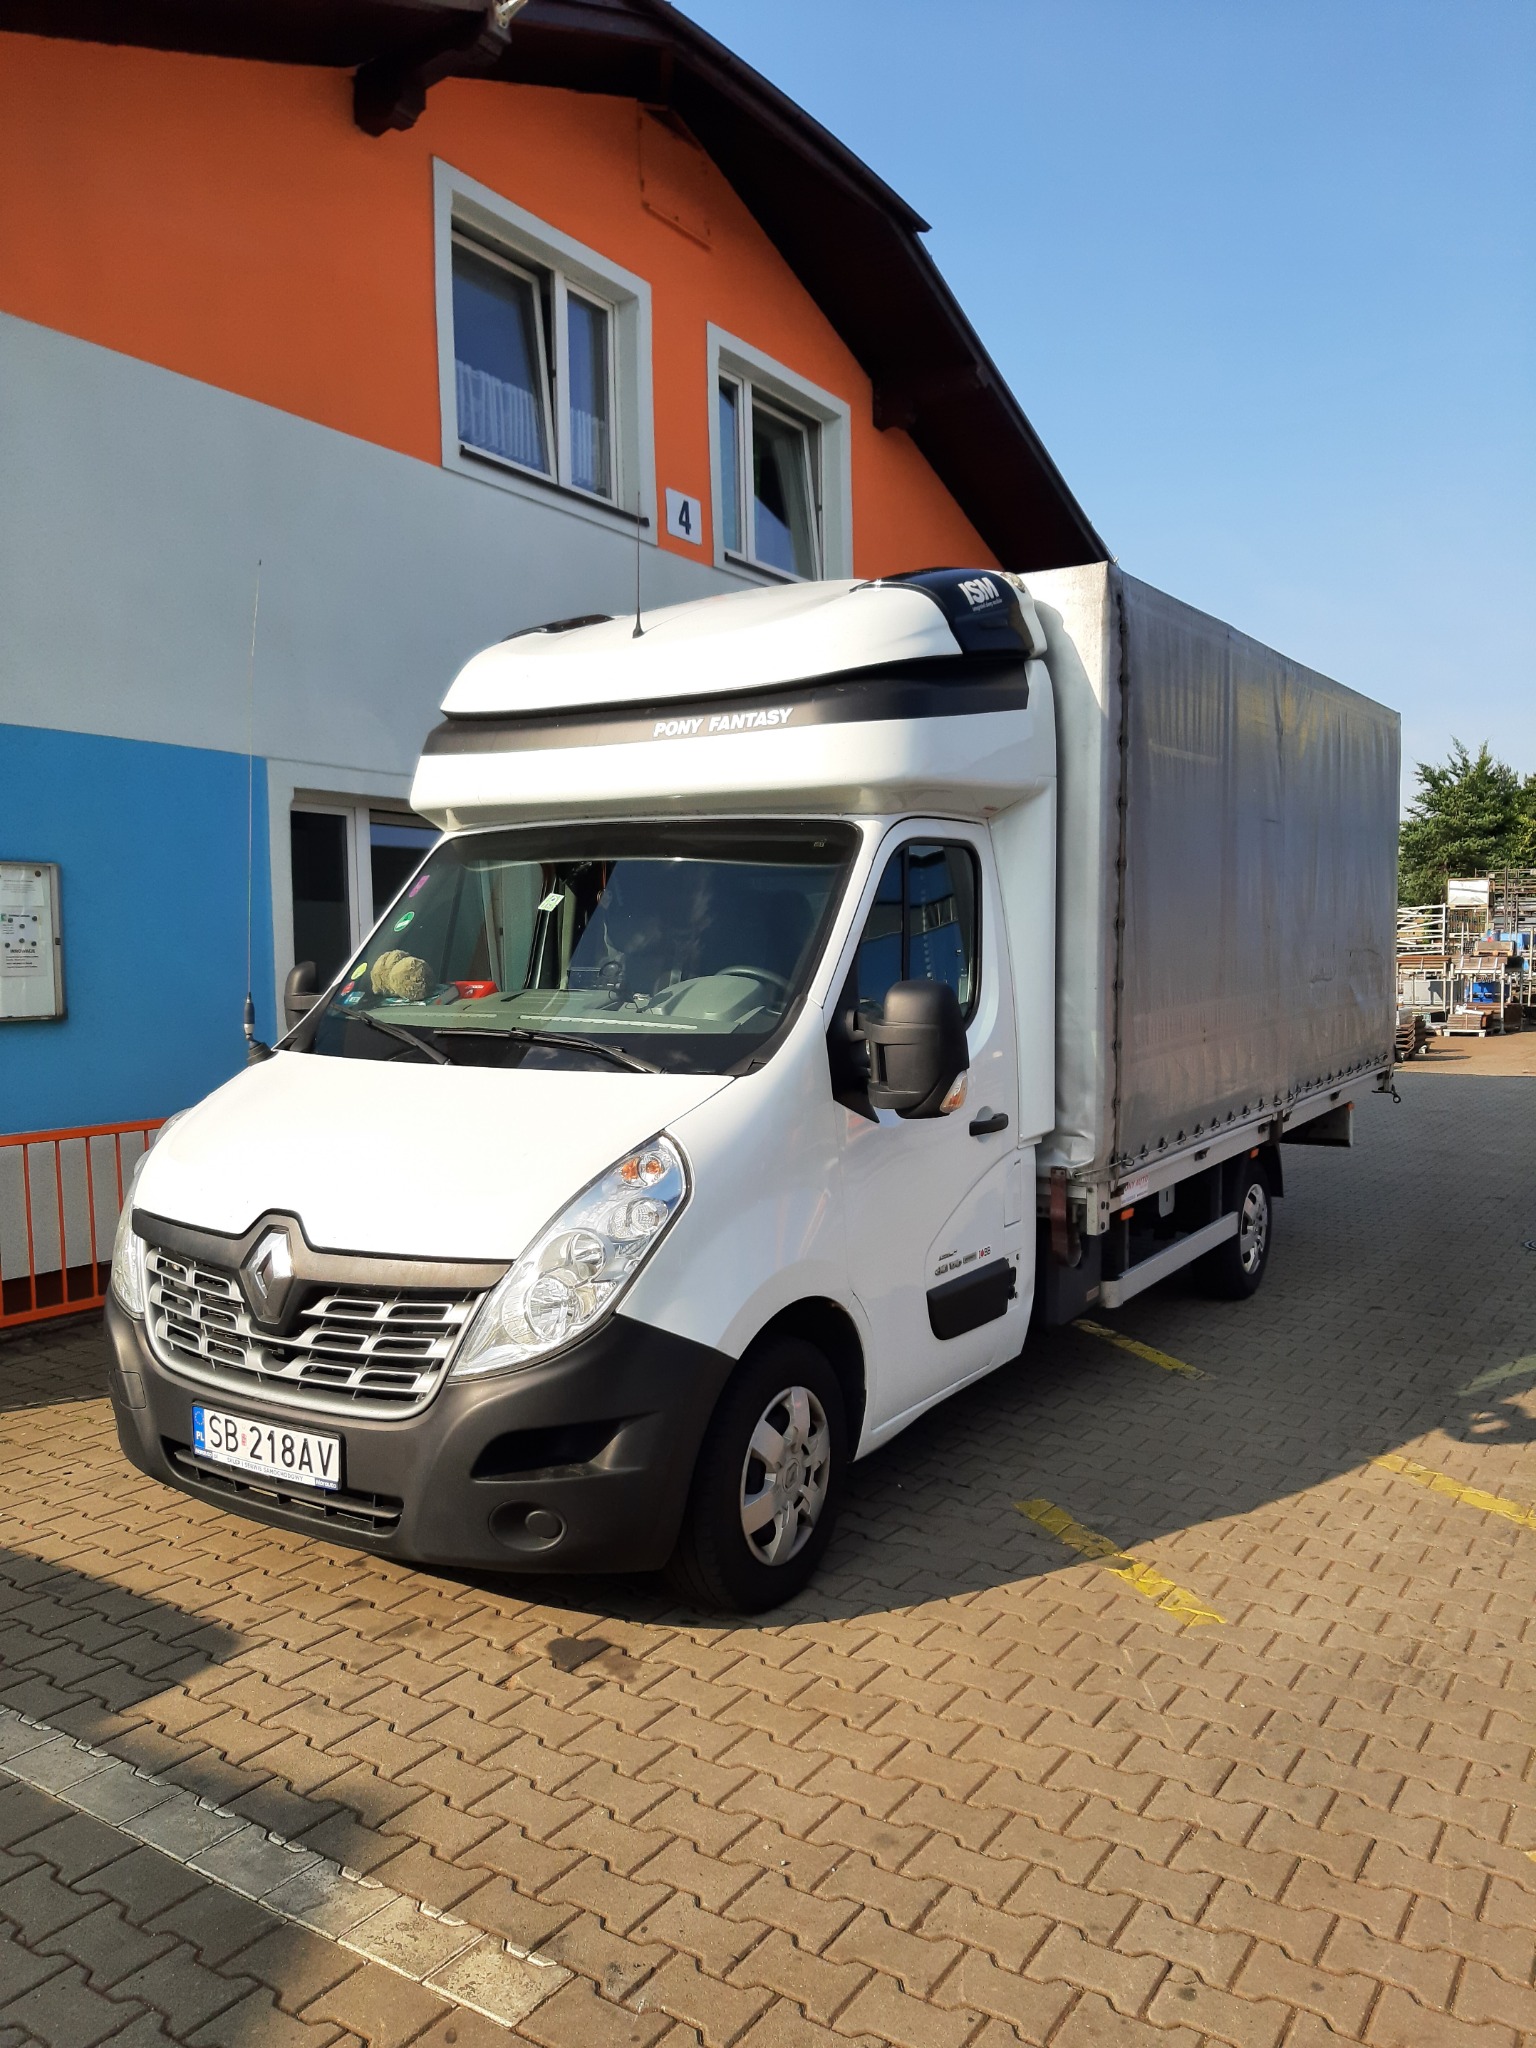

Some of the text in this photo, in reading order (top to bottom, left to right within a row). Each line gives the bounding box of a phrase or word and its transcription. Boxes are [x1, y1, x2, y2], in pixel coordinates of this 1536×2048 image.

[678, 500, 692, 535] 4
[958, 577, 999, 605] ISM
[653, 707, 793, 737] PONY FANTASY
[196, 1430, 205, 1442] PL
[249, 1426, 334, 1476] 218AV
[315, 1479, 337, 1489] Norauto
